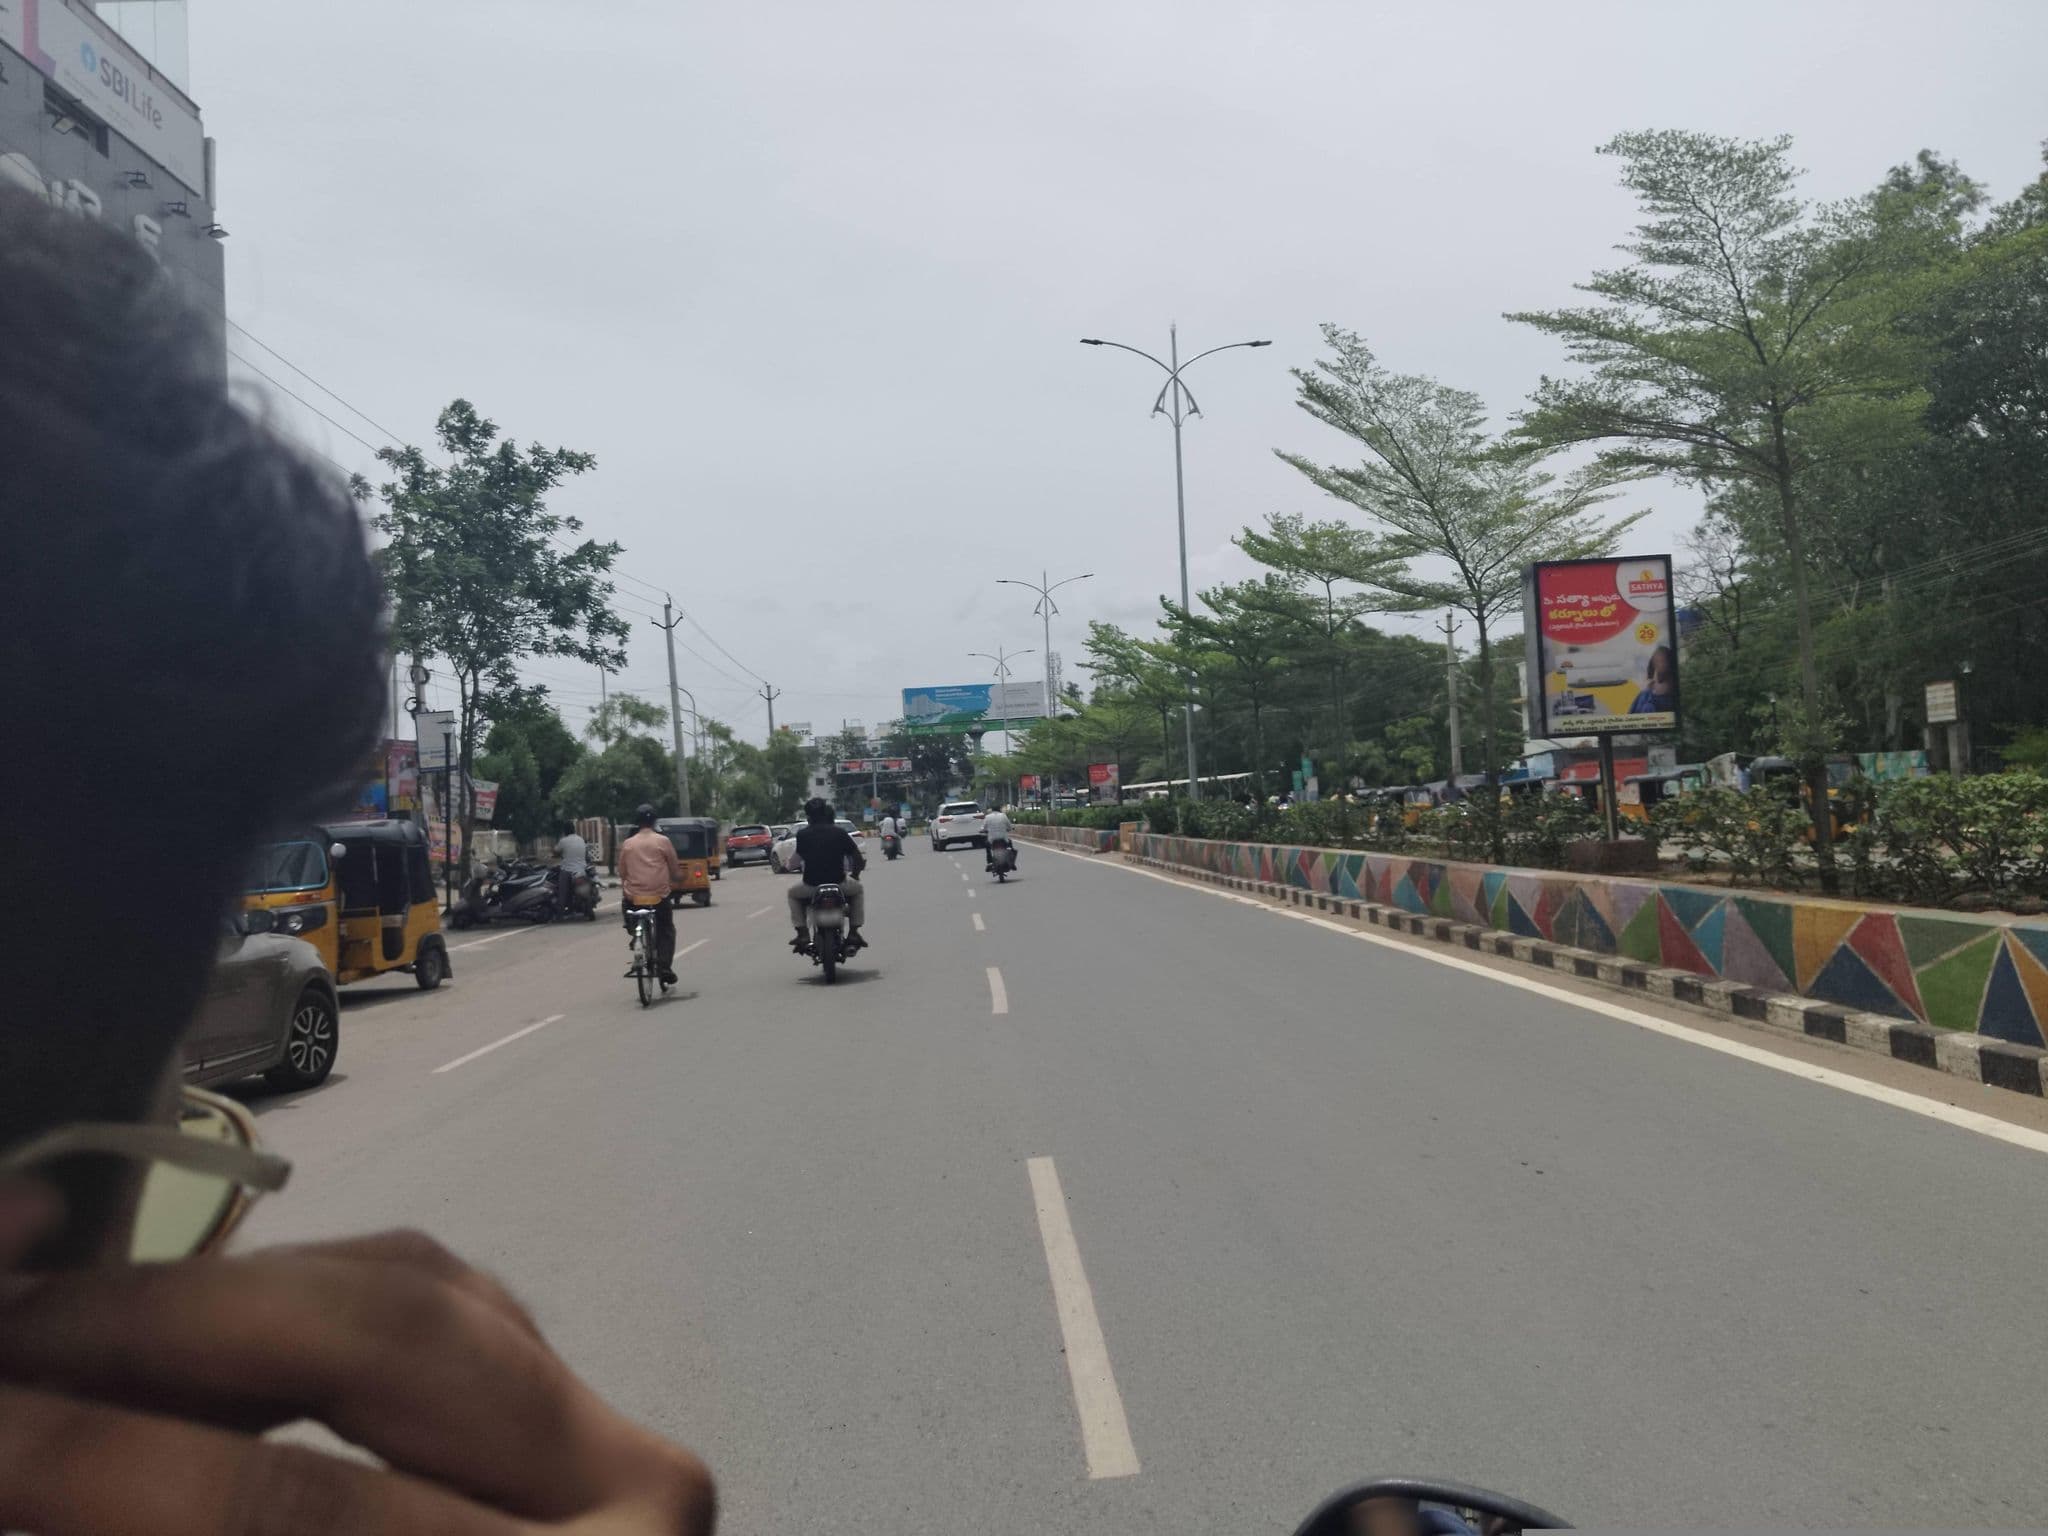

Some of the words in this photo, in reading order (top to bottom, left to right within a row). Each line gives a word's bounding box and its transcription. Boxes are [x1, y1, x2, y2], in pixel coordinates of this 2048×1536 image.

[100, 57, 130, 103] SBI
[132, 84, 163, 130] Life
[1631, 582, 1664, 592] SATHYA
